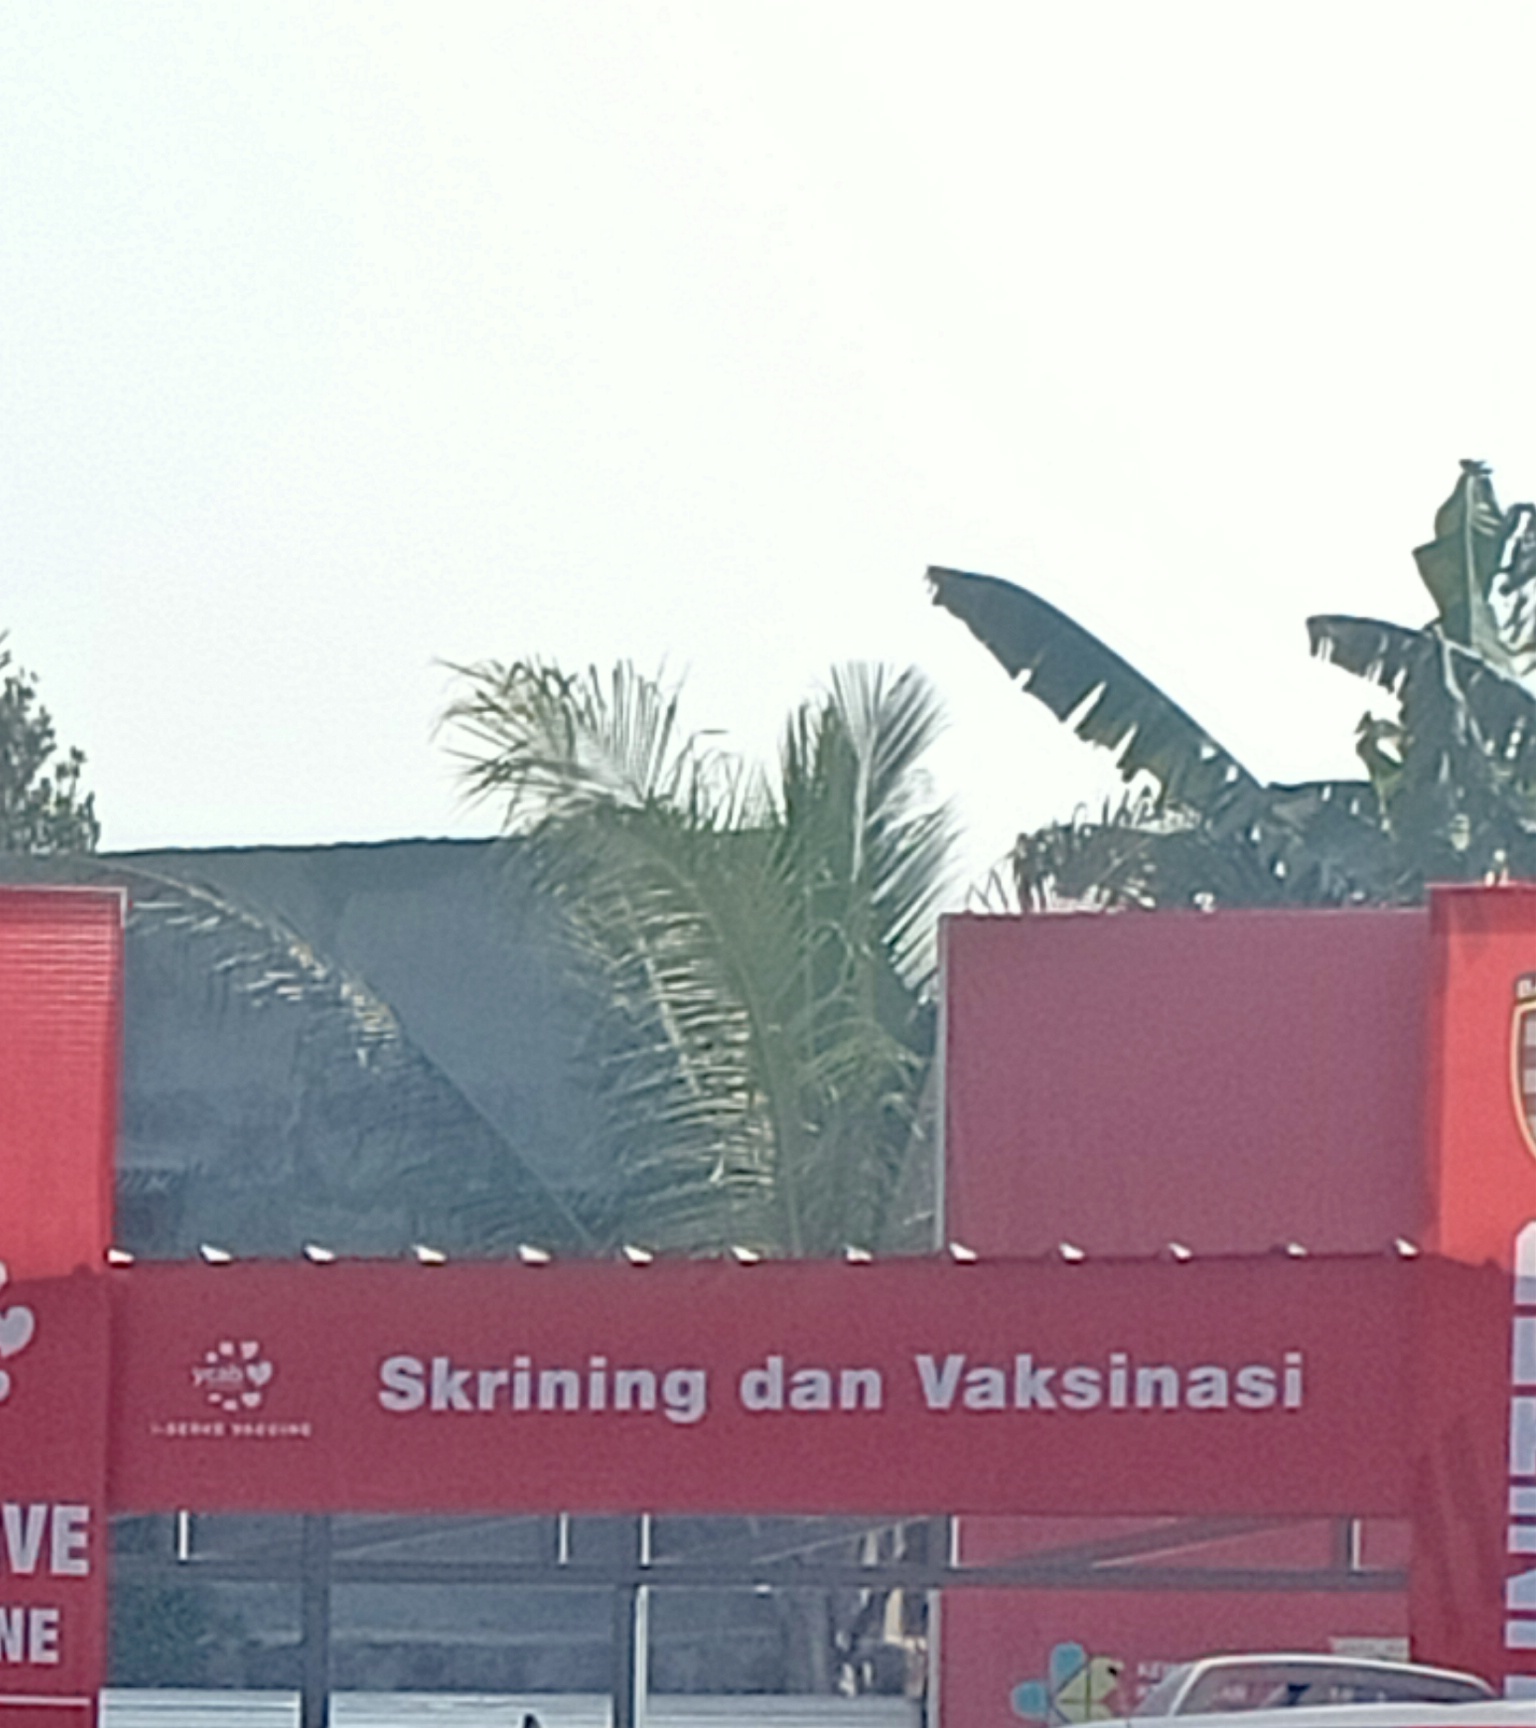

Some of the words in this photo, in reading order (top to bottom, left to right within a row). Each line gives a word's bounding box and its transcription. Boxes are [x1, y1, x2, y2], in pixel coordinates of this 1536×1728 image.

[378, 1355, 707, 1424] Skrining
[739, 1355, 883, 1411] dan
[914, 1352, 1302, 1411] Vaksinasi
